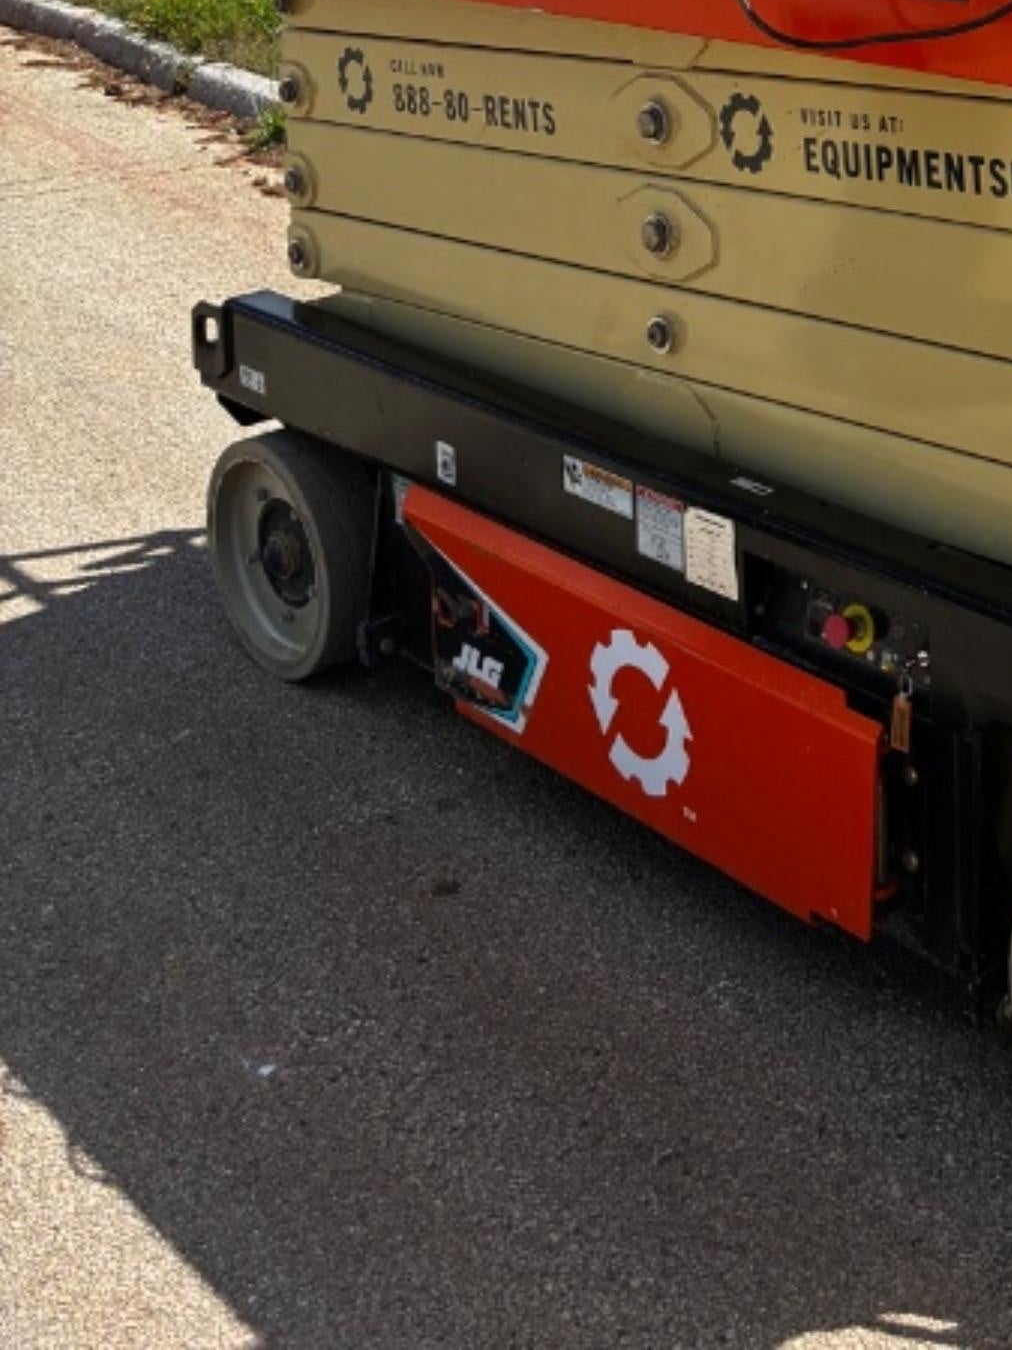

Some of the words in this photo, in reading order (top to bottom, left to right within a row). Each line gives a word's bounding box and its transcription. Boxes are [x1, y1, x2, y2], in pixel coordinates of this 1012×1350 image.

[392, 82, 557, 137] 888-80-RENTS
[801, 107, 842, 128] VISIT
[850, 112, 871, 131] US
[878, 114, 904, 134] AT:
[452, 642, 505, 689] JLG
